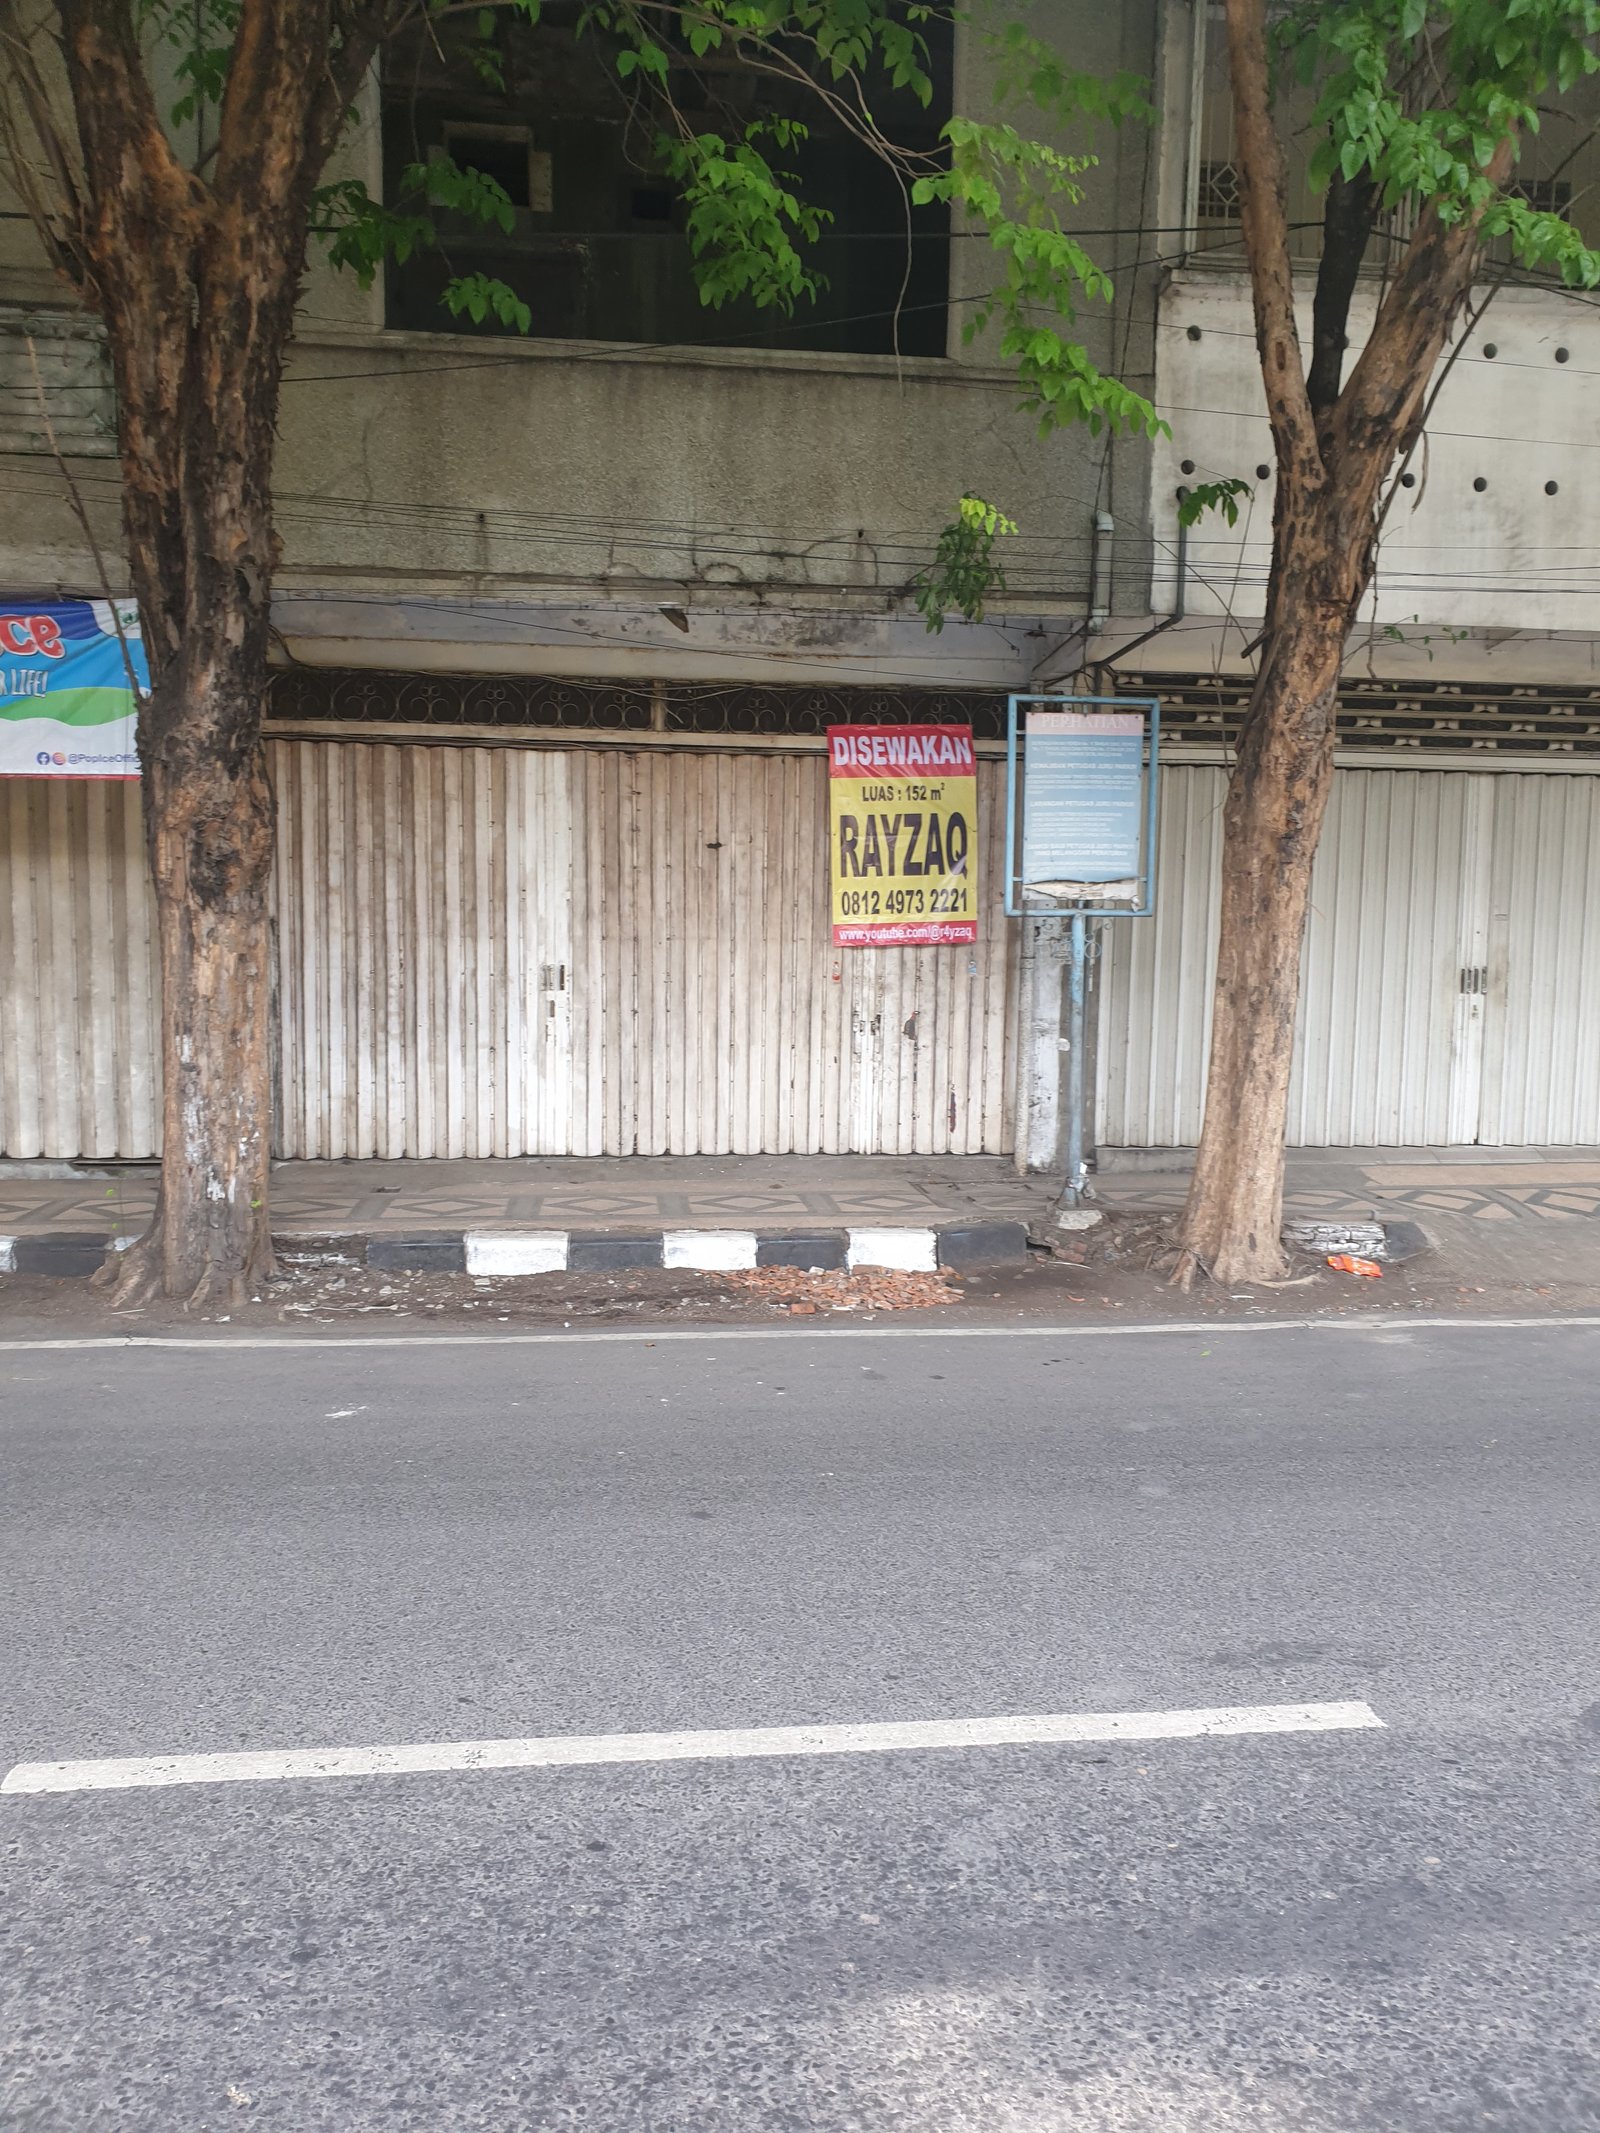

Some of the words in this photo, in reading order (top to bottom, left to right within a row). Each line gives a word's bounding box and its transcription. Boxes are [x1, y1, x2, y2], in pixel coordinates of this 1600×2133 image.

[11, 669, 48, 698] LIFE!
[1041, 715, 1129, 729] PERHATIAN
[832, 735, 972, 766] DISEWAKAN
[862, 785, 894, 802] LUAS
[906, 785, 926, 801] 152
[839, 811, 968, 879] RAYZAQ
[841, 890, 880, 916] 0812
[885, 889, 924, 914] 4973
[929, 887, 967, 912] 2221
